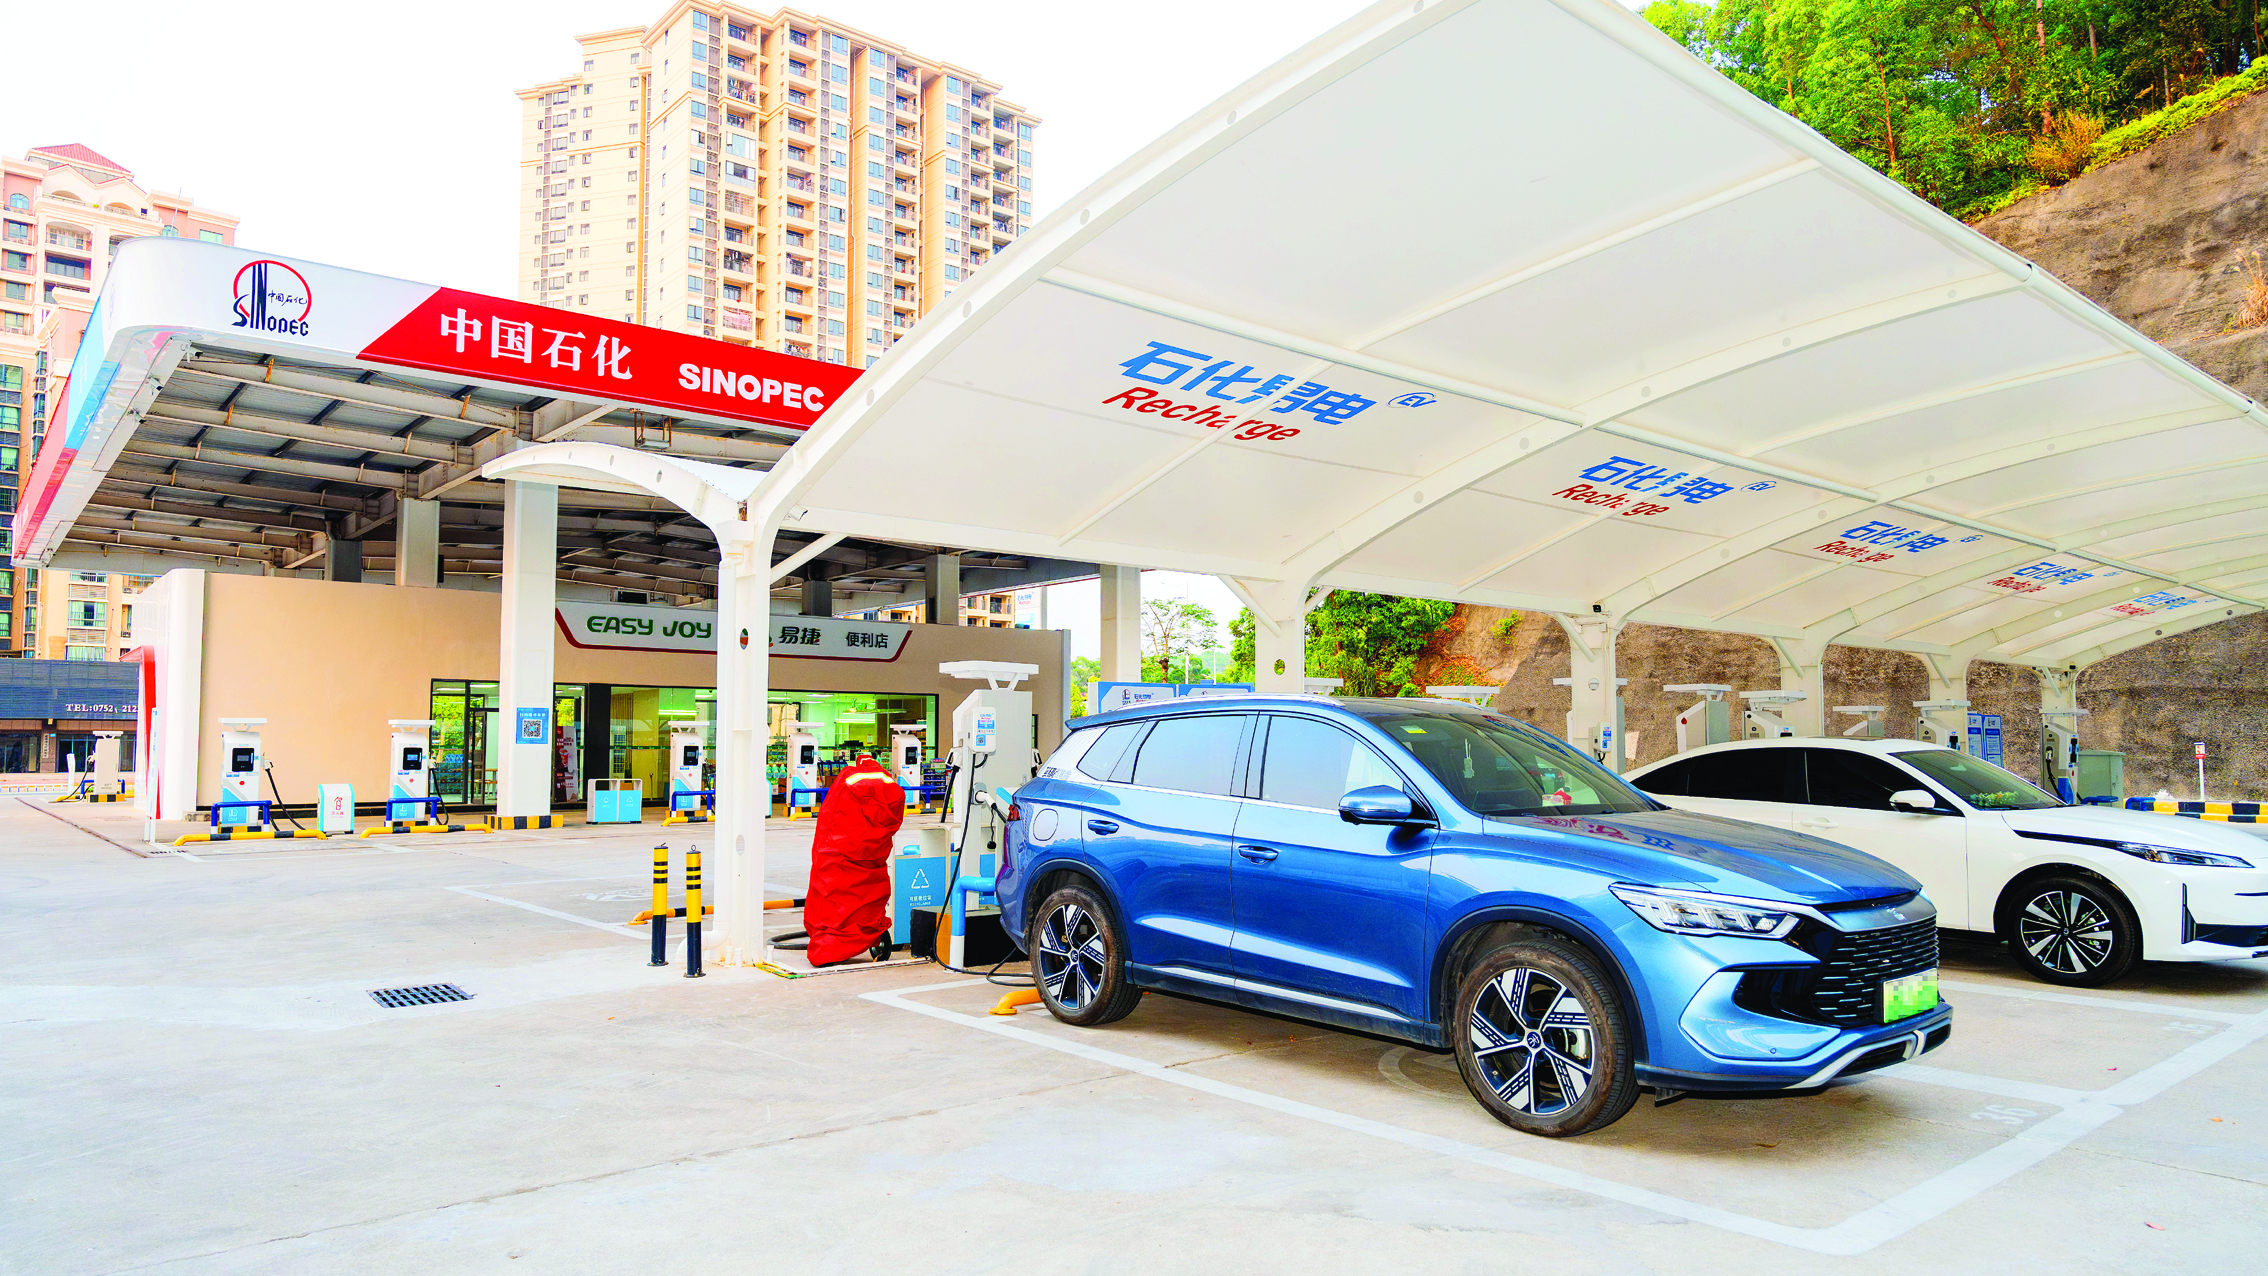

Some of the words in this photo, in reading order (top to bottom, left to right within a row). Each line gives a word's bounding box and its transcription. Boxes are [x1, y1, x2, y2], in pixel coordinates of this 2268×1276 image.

[440, 308, 633, 380] 中国石化
[678, 363, 825, 412] SINOPEC
[586, 615, 654, 636] EASY
[662, 621, 712, 639] JOY
[779, 626, 821, 646] 易捷
[845, 631, 889, 648] 便利店
